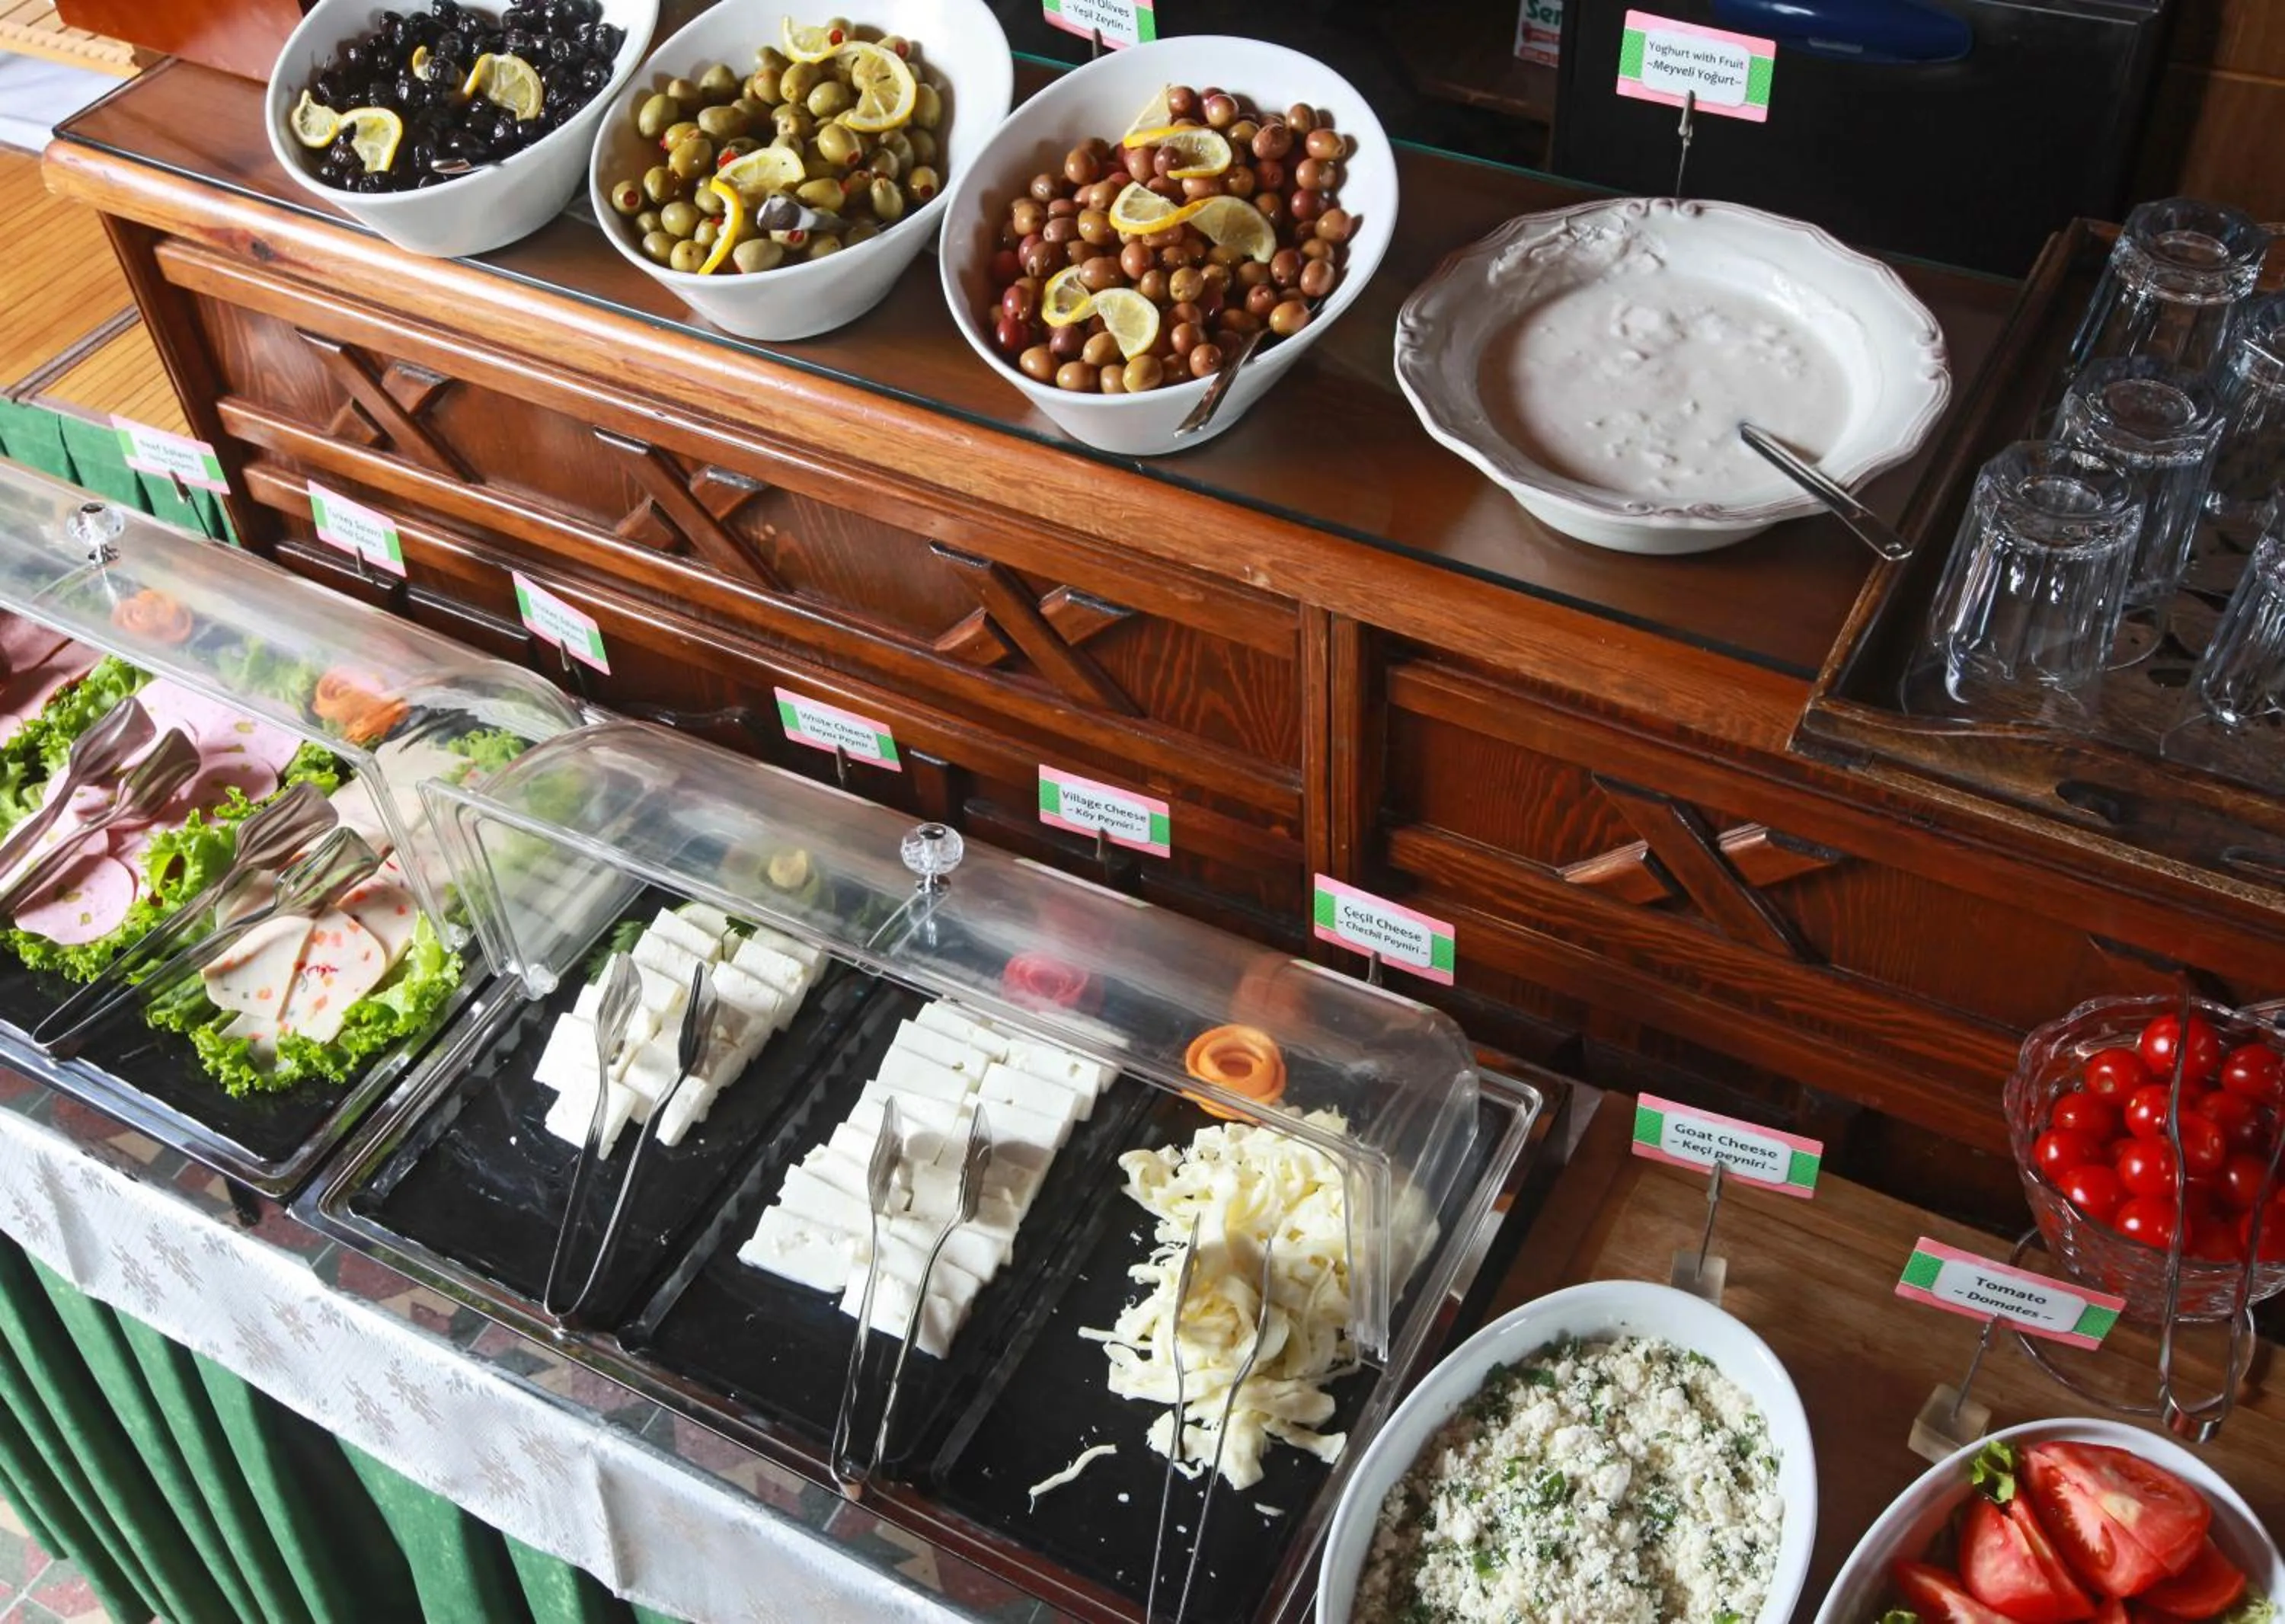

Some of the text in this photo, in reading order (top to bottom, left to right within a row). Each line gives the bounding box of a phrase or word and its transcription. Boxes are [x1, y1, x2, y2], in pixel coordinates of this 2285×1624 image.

[1095, 14, 1123, 30] Zeytin
[1098, 0, 1130, 17] Olives
[1650, 41, 1743, 69] Yoghurt with Fruit
[800, 711, 872, 740] White Cheese
[1063, 791, 1146, 823] Village Cheese
[1075, 807, 1134, 830] Köy Peyniri
[1344, 906, 1422, 941] Çeçil Cheese
[1346, 921, 1419, 954] Chechil Peyniri
[1675, 1124, 1778, 1159] Goat Cheese
[1683, 1140, 1766, 1170] Keçi peyniri
[1976, 1276, 2047, 1305] Tomato
[1967, 1292, 2038, 1319] Domates
